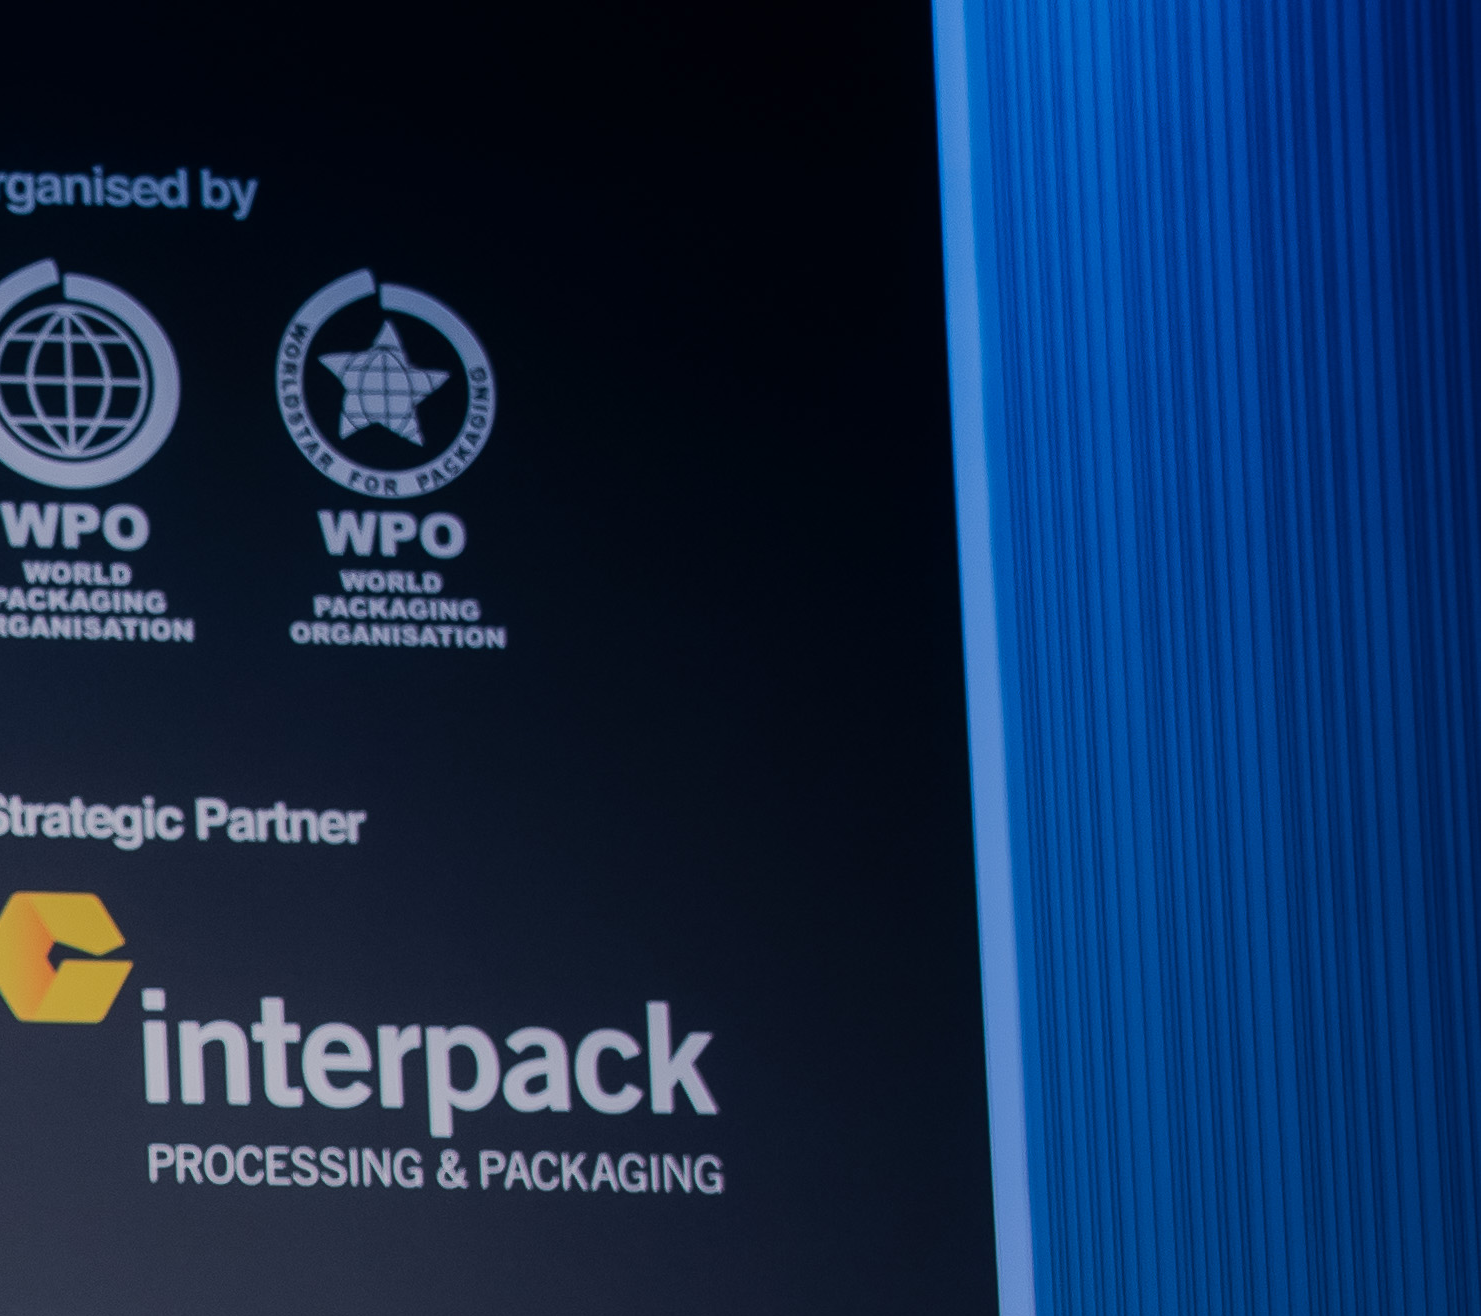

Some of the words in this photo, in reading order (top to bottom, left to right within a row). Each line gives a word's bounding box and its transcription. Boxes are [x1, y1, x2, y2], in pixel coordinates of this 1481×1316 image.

[201, 169, 257, 220] by
[280, 322, 335, 473] WORLDSTAR
[348, 470, 399, 496] FOR
[415, 366, 491, 492] PACKAGING
[0, 502, 149, 550] WPO
[318, 510, 465, 558] WPO
[23, 561, 132, 586] WORLD
[340, 570, 442, 594] WORLD
[314, 596, 481, 621] PACKAGING
[290, 622, 507, 648] ORGANISATION
[195, 798, 366, 844] Partner
[142, 988, 717, 1139] interpack
[148, 1143, 423, 1189] PROCESSING
[437, 1149, 468, 1189] &
[479, 1150, 723, 1194] PACKAGING
